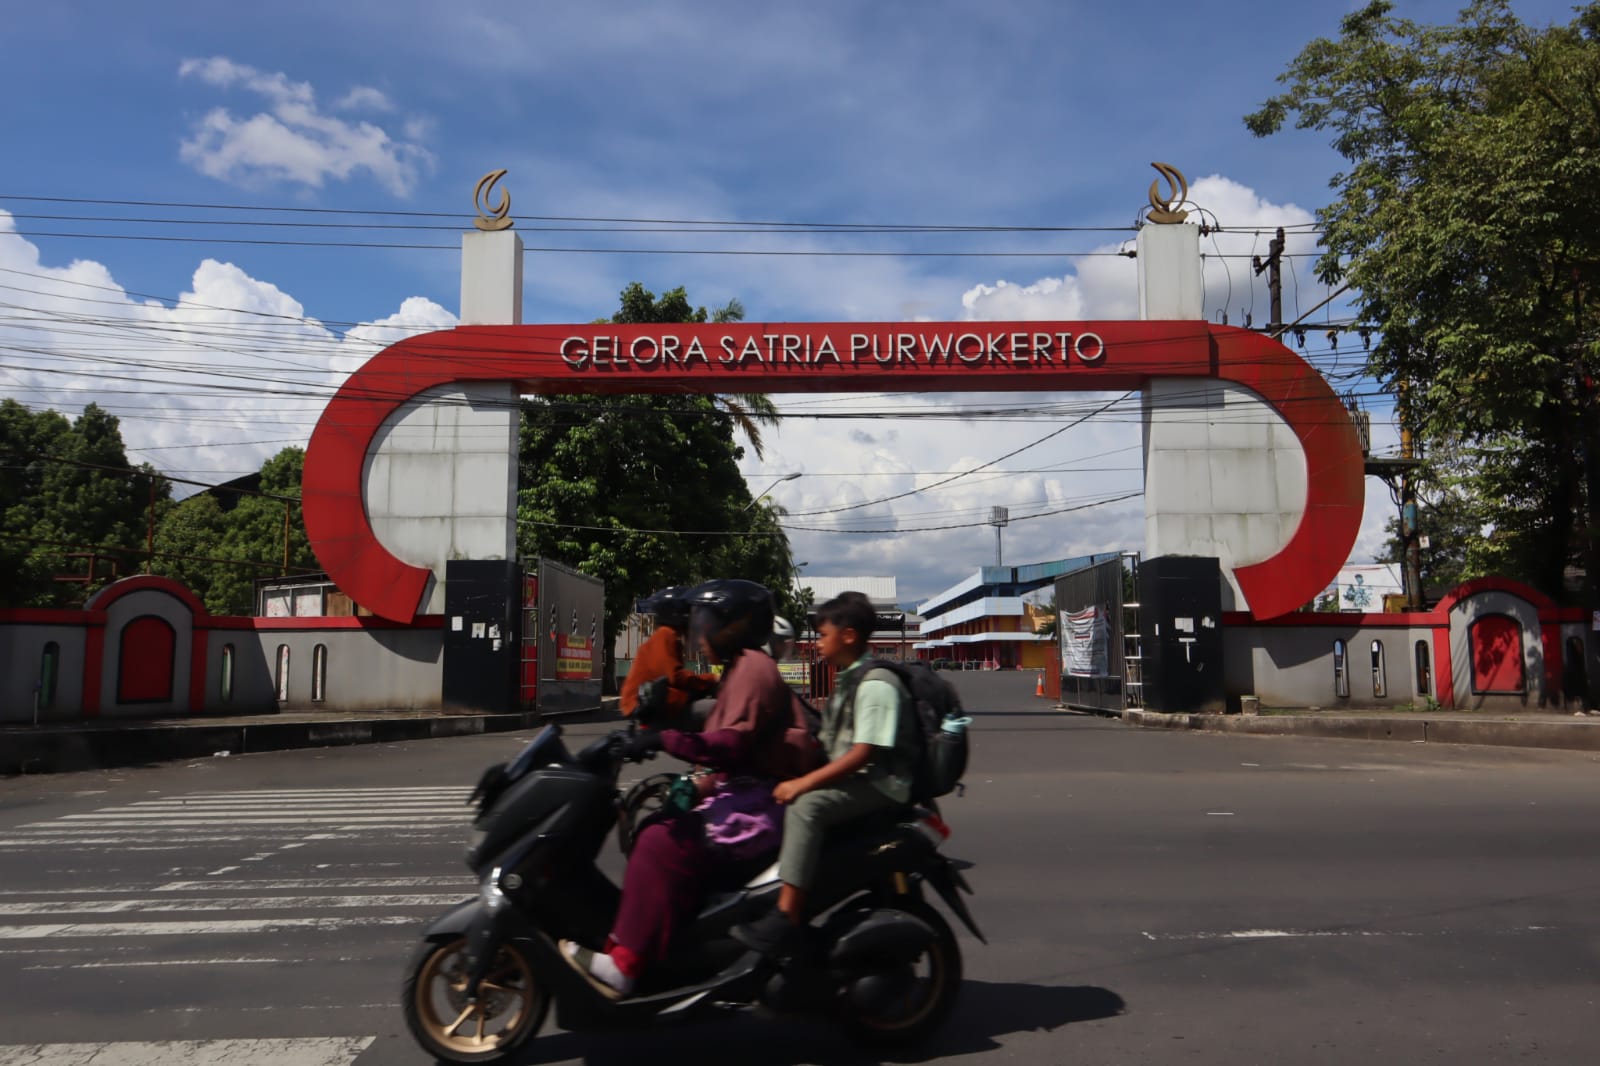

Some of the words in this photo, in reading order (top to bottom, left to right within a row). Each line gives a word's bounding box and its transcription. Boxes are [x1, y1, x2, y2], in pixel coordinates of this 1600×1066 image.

[560, 336, 708, 364] GELORA
[718, 335, 841, 363] SATRIA
[850, 333, 1104, 362] PURWOKERTO
